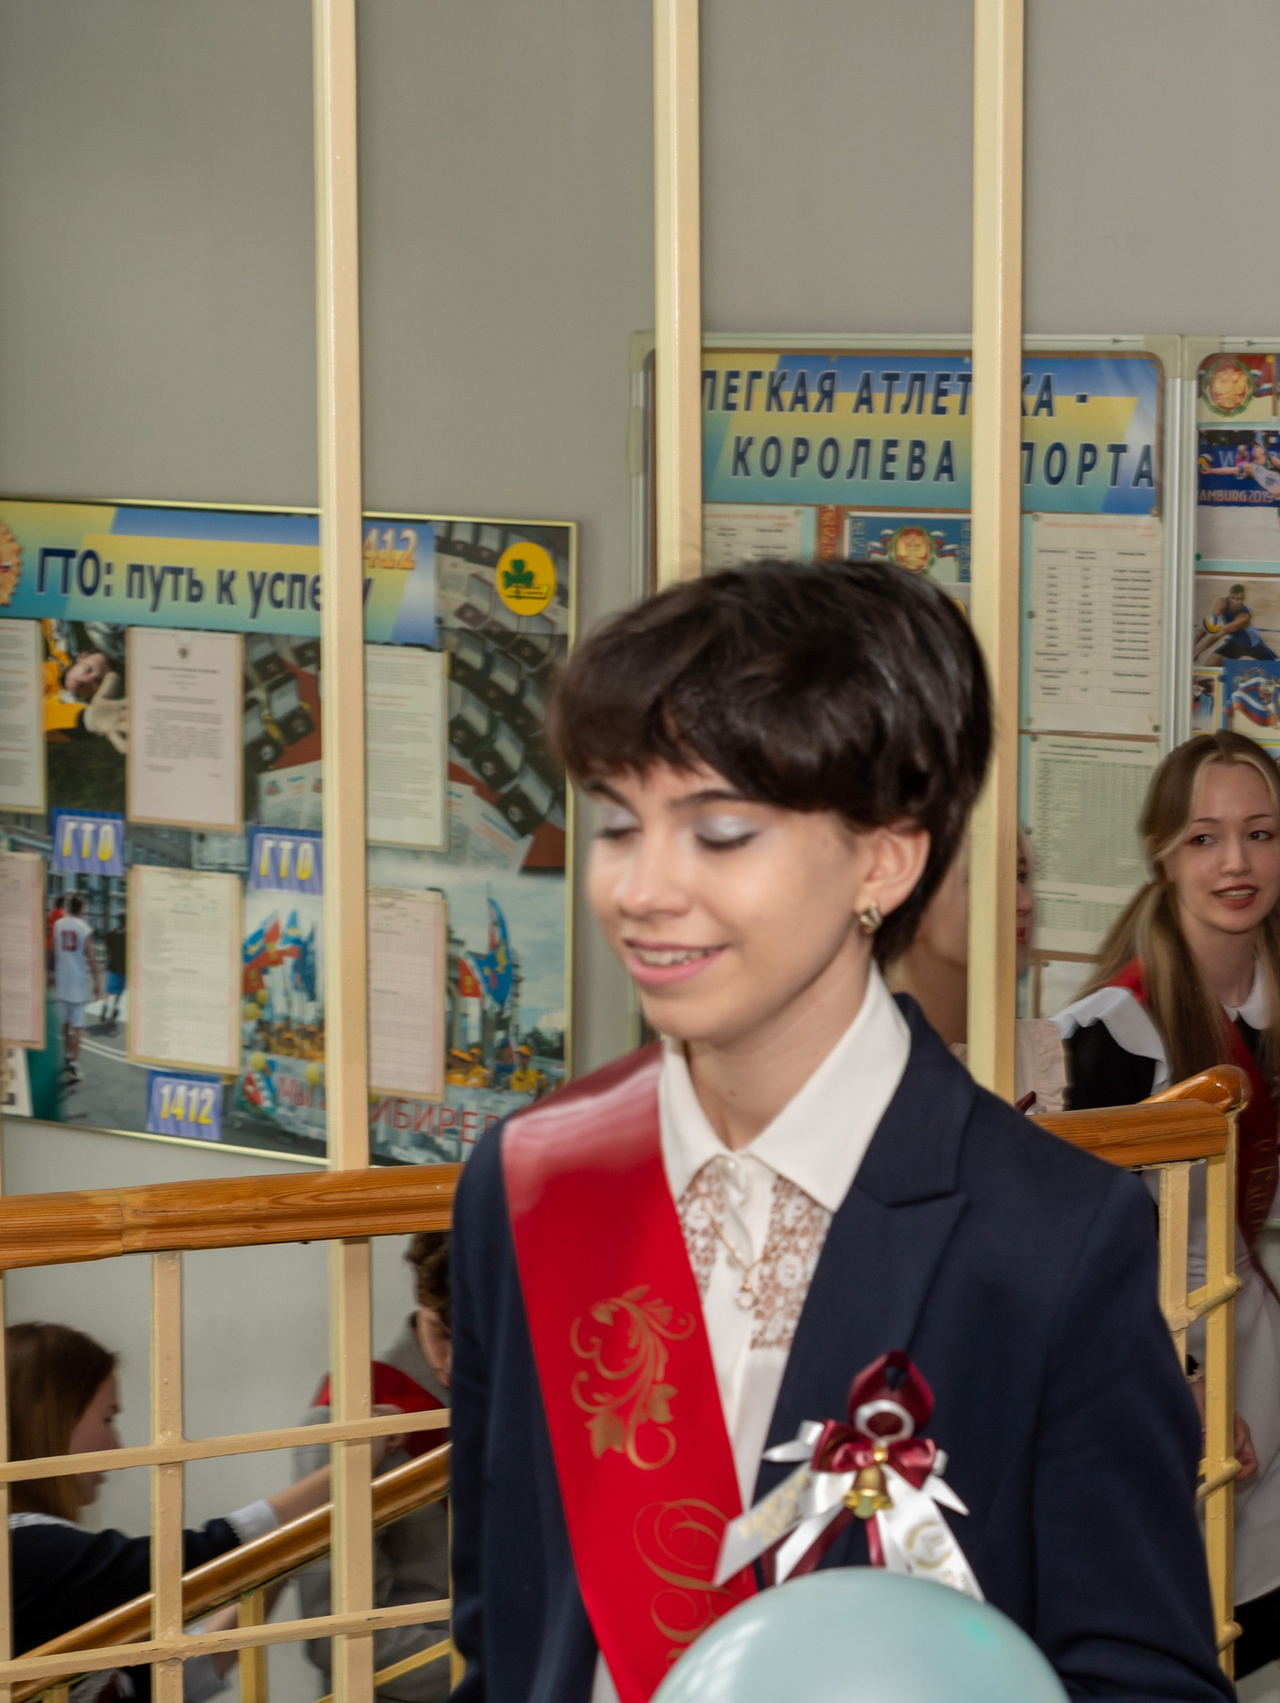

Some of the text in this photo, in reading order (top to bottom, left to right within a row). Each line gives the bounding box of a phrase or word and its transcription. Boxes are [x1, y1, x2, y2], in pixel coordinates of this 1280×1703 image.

[702, 370, 838, 413] ЛЕГКАЯ
[731, 436, 1155, 488] КОРОЛЕВА ПОРТА
[362, 527, 418, 571] 412
[36, 547, 113, 598] ГТО:
[126, 562, 205, 612] путь
[217, 568, 238, 605] к
[62, 820, 115, 861] ГТО
[259, 838, 315, 880] ГТО
[160, 1083, 215, 1125] 1412
